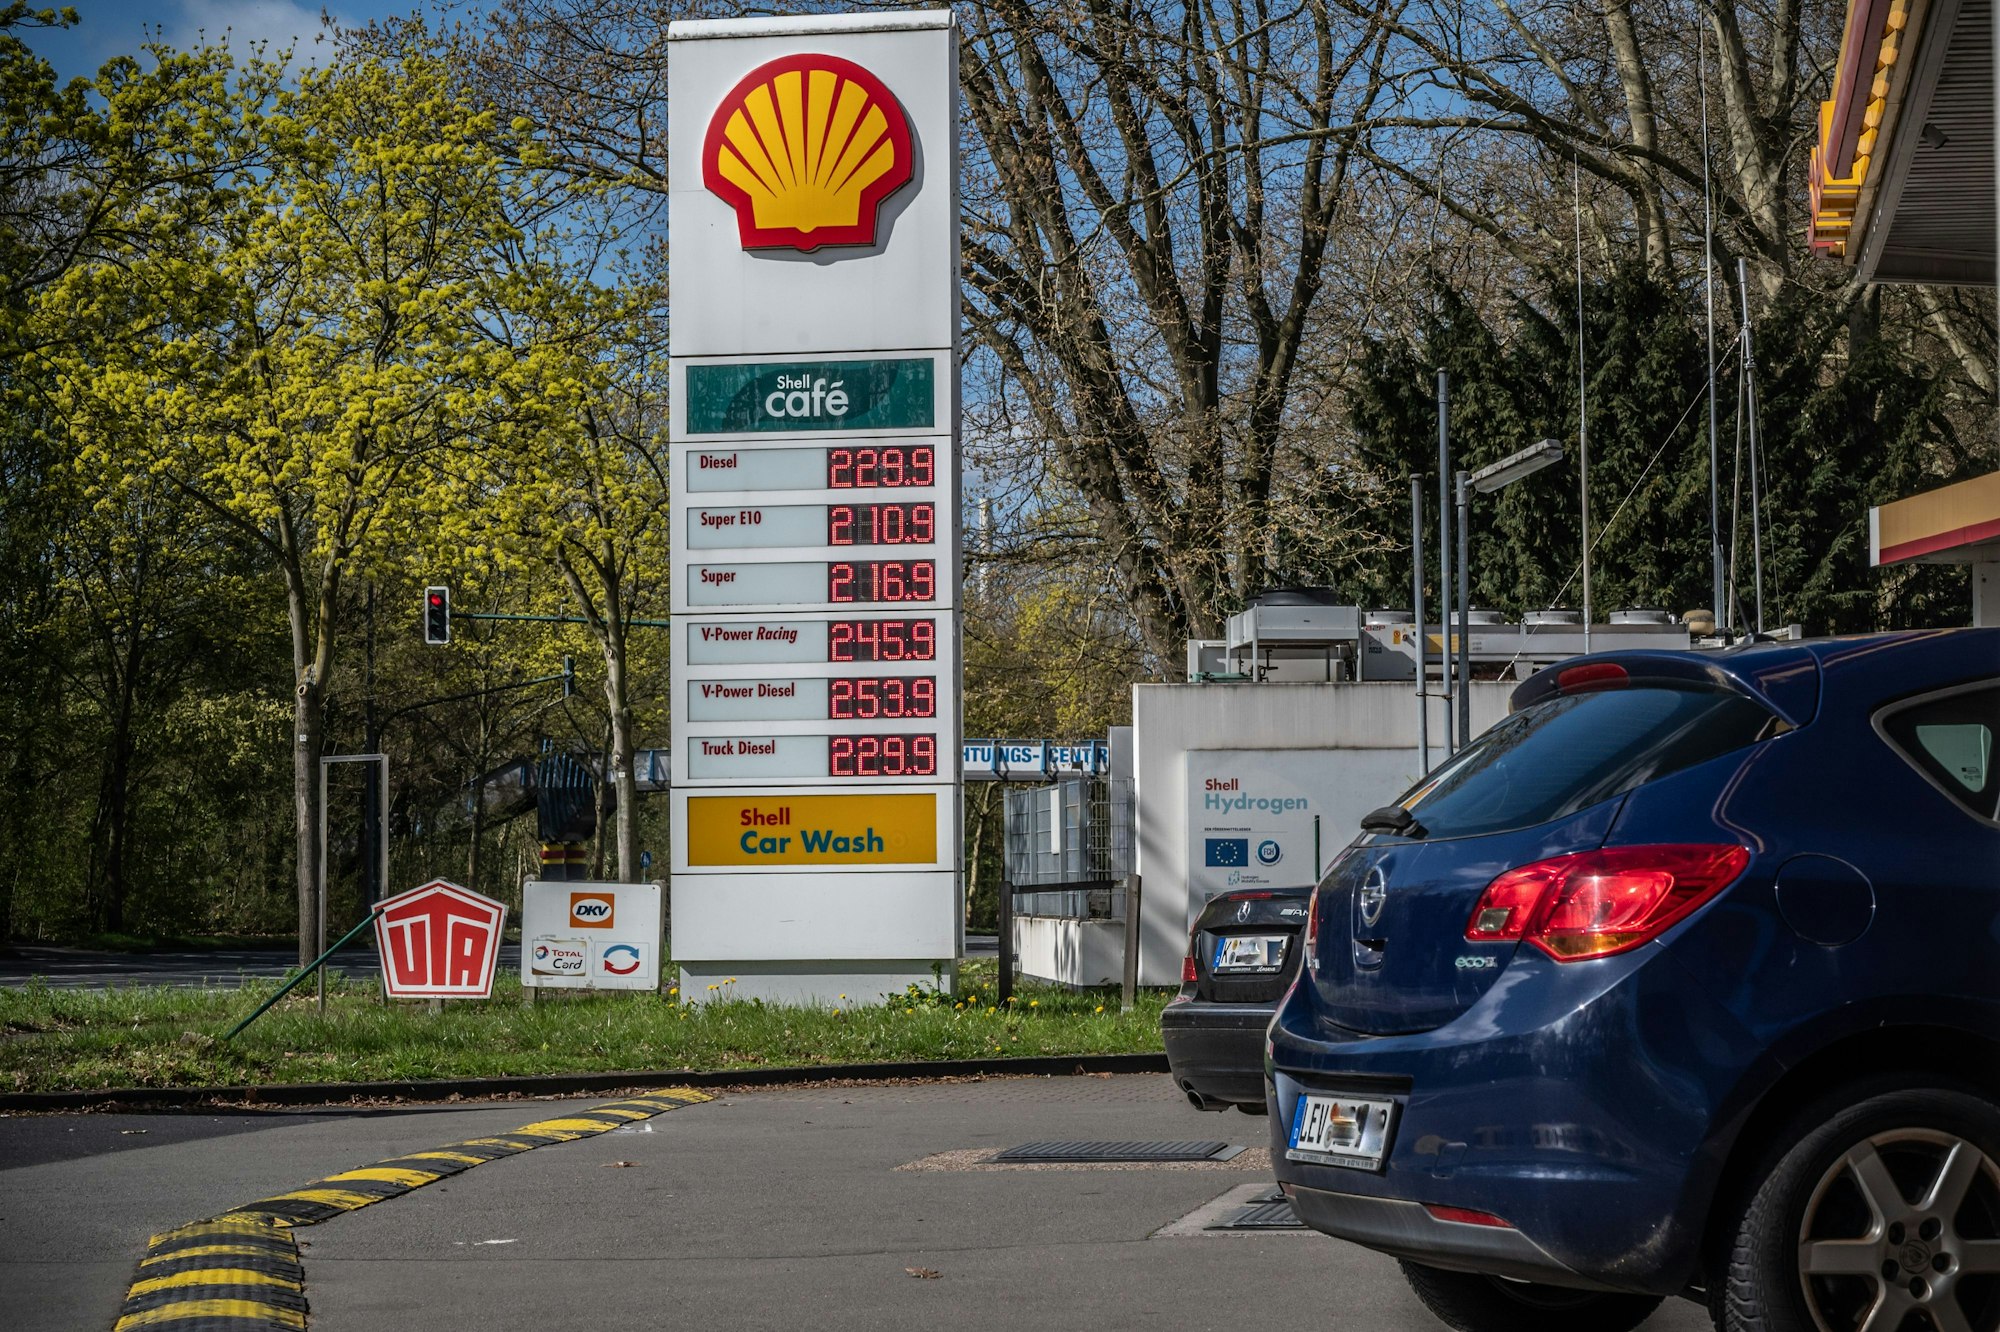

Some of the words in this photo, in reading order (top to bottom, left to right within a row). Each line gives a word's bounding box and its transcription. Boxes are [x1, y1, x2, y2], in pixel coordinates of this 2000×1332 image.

[765, 378, 849, 418] café
[777, 374, 810, 389] Shell
[700, 454, 737, 469] Diesel
[831, 448, 933, 488] 229.9
[701, 512, 736, 529] Super
[740, 511, 762, 525] E10
[831, 505, 934, 545] 210.9
[701, 570, 736, 586] Super
[831, 562, 934, 602] 216.9
[701, 627, 753, 641] V-Power
[756, 626, 798, 644] Racing
[831, 622, 934, 661] 245.9
[701, 684, 754, 698] V-Power
[758, 682, 795, 697] Diesel
[831, 678, 934, 718] 253.9
[702, 741, 734, 755] Truck
[738, 740, 775, 755] Diesel
[832, 736, 935, 776] 229.9
[1205, 778, 1239, 791] Shell
[740, 807, 790, 826] Shell
[1205, 792, 1308, 815] Hydrogen
[740, 830, 791, 855] Car
[800, 827, 884, 854] Wash
[576, 904, 609, 916] DKV
[385, 891, 493, 986] UTA
[552, 949, 583, 958] TOTAL
[553, 958, 583, 970] Card
